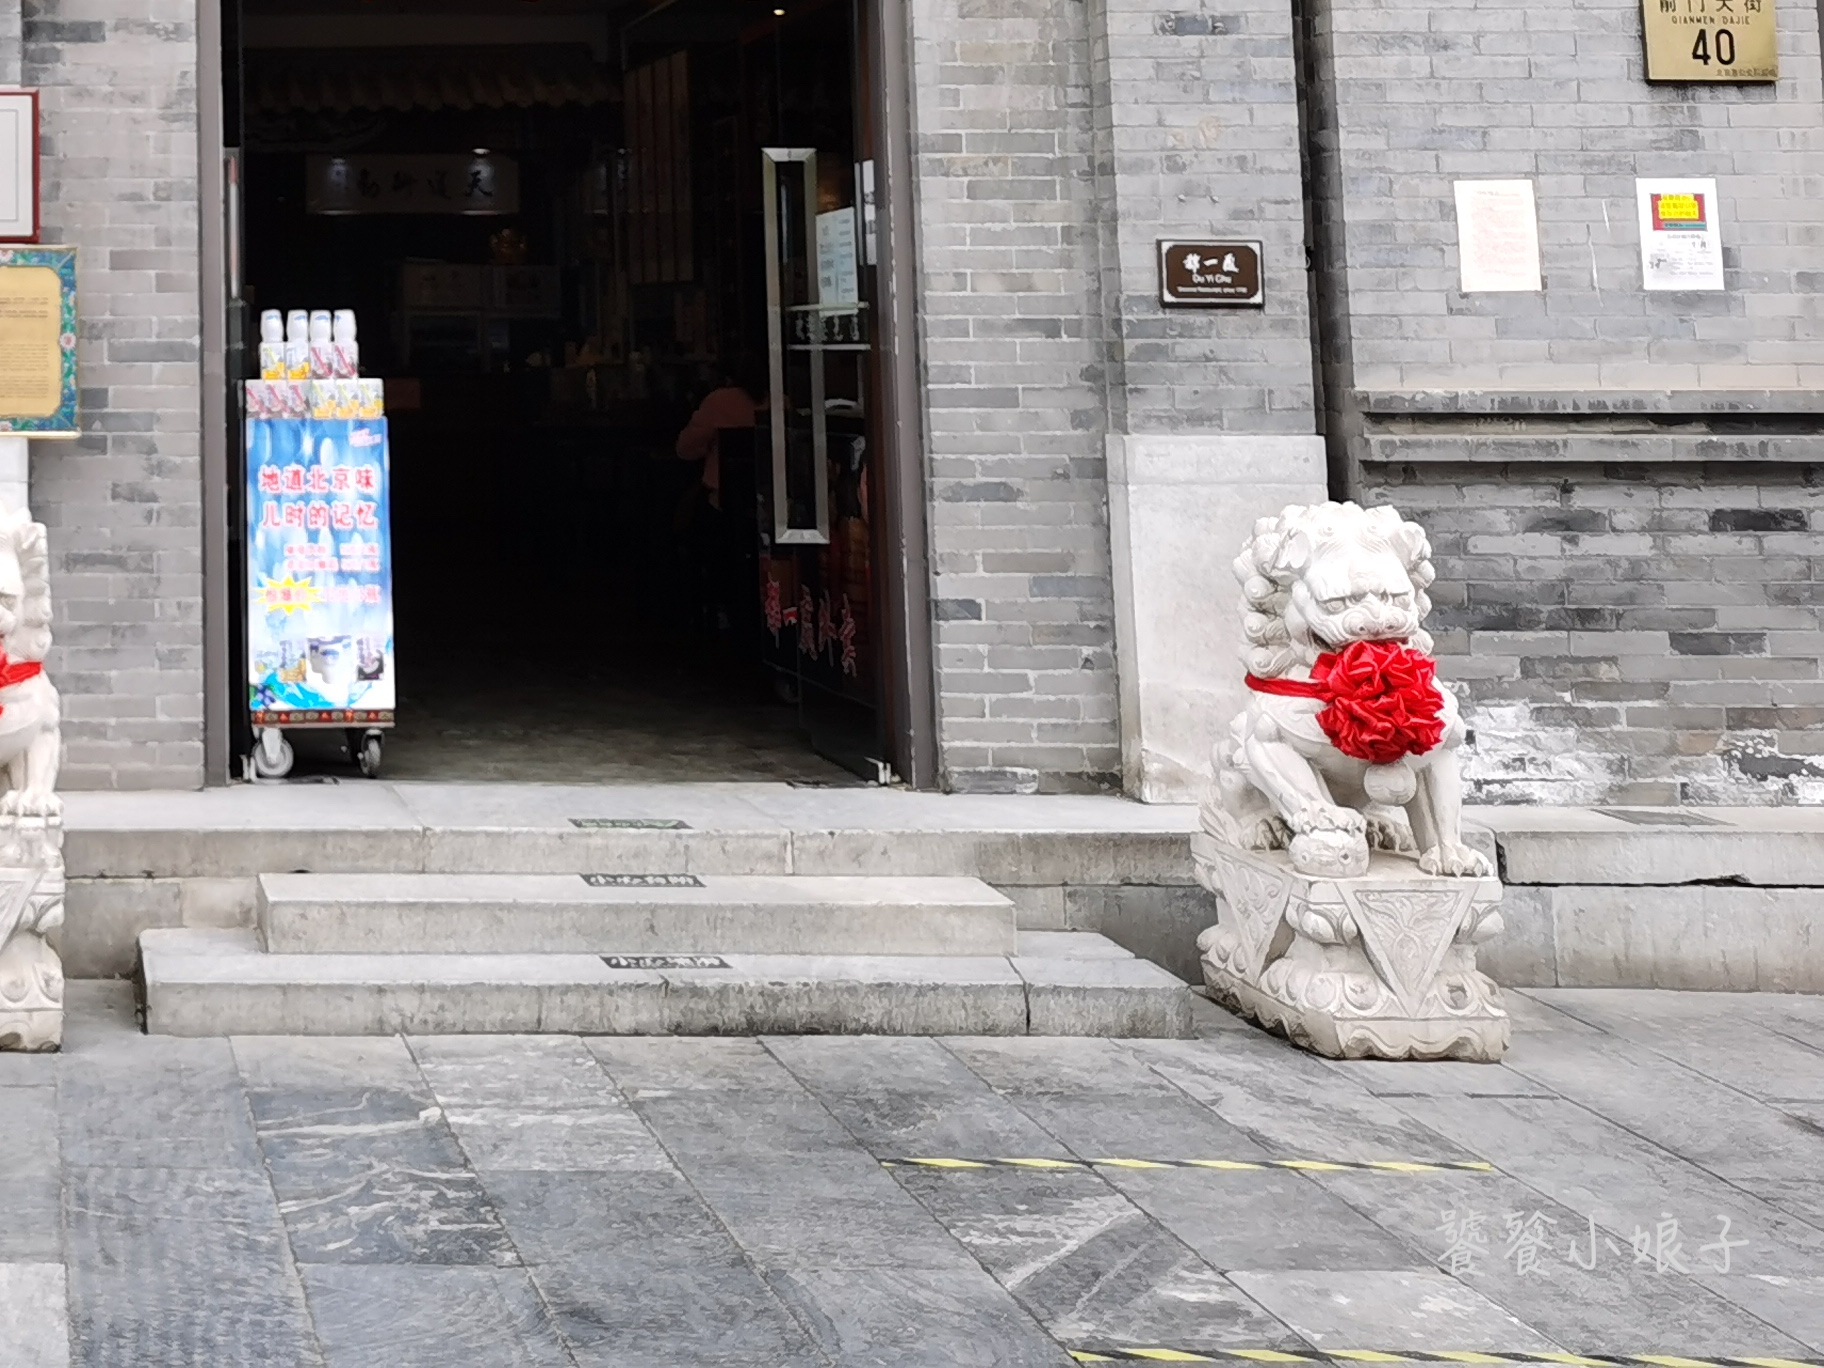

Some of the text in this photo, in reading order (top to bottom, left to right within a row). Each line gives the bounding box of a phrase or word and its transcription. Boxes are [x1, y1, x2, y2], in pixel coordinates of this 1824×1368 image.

[1671, 16, 1751, 25] QIANMEN DAJIE
[1692, 28, 1736, 66] 40
[260, 466, 375, 492] 地道北京味
[262, 501, 378, 528] 儿时的记忆
